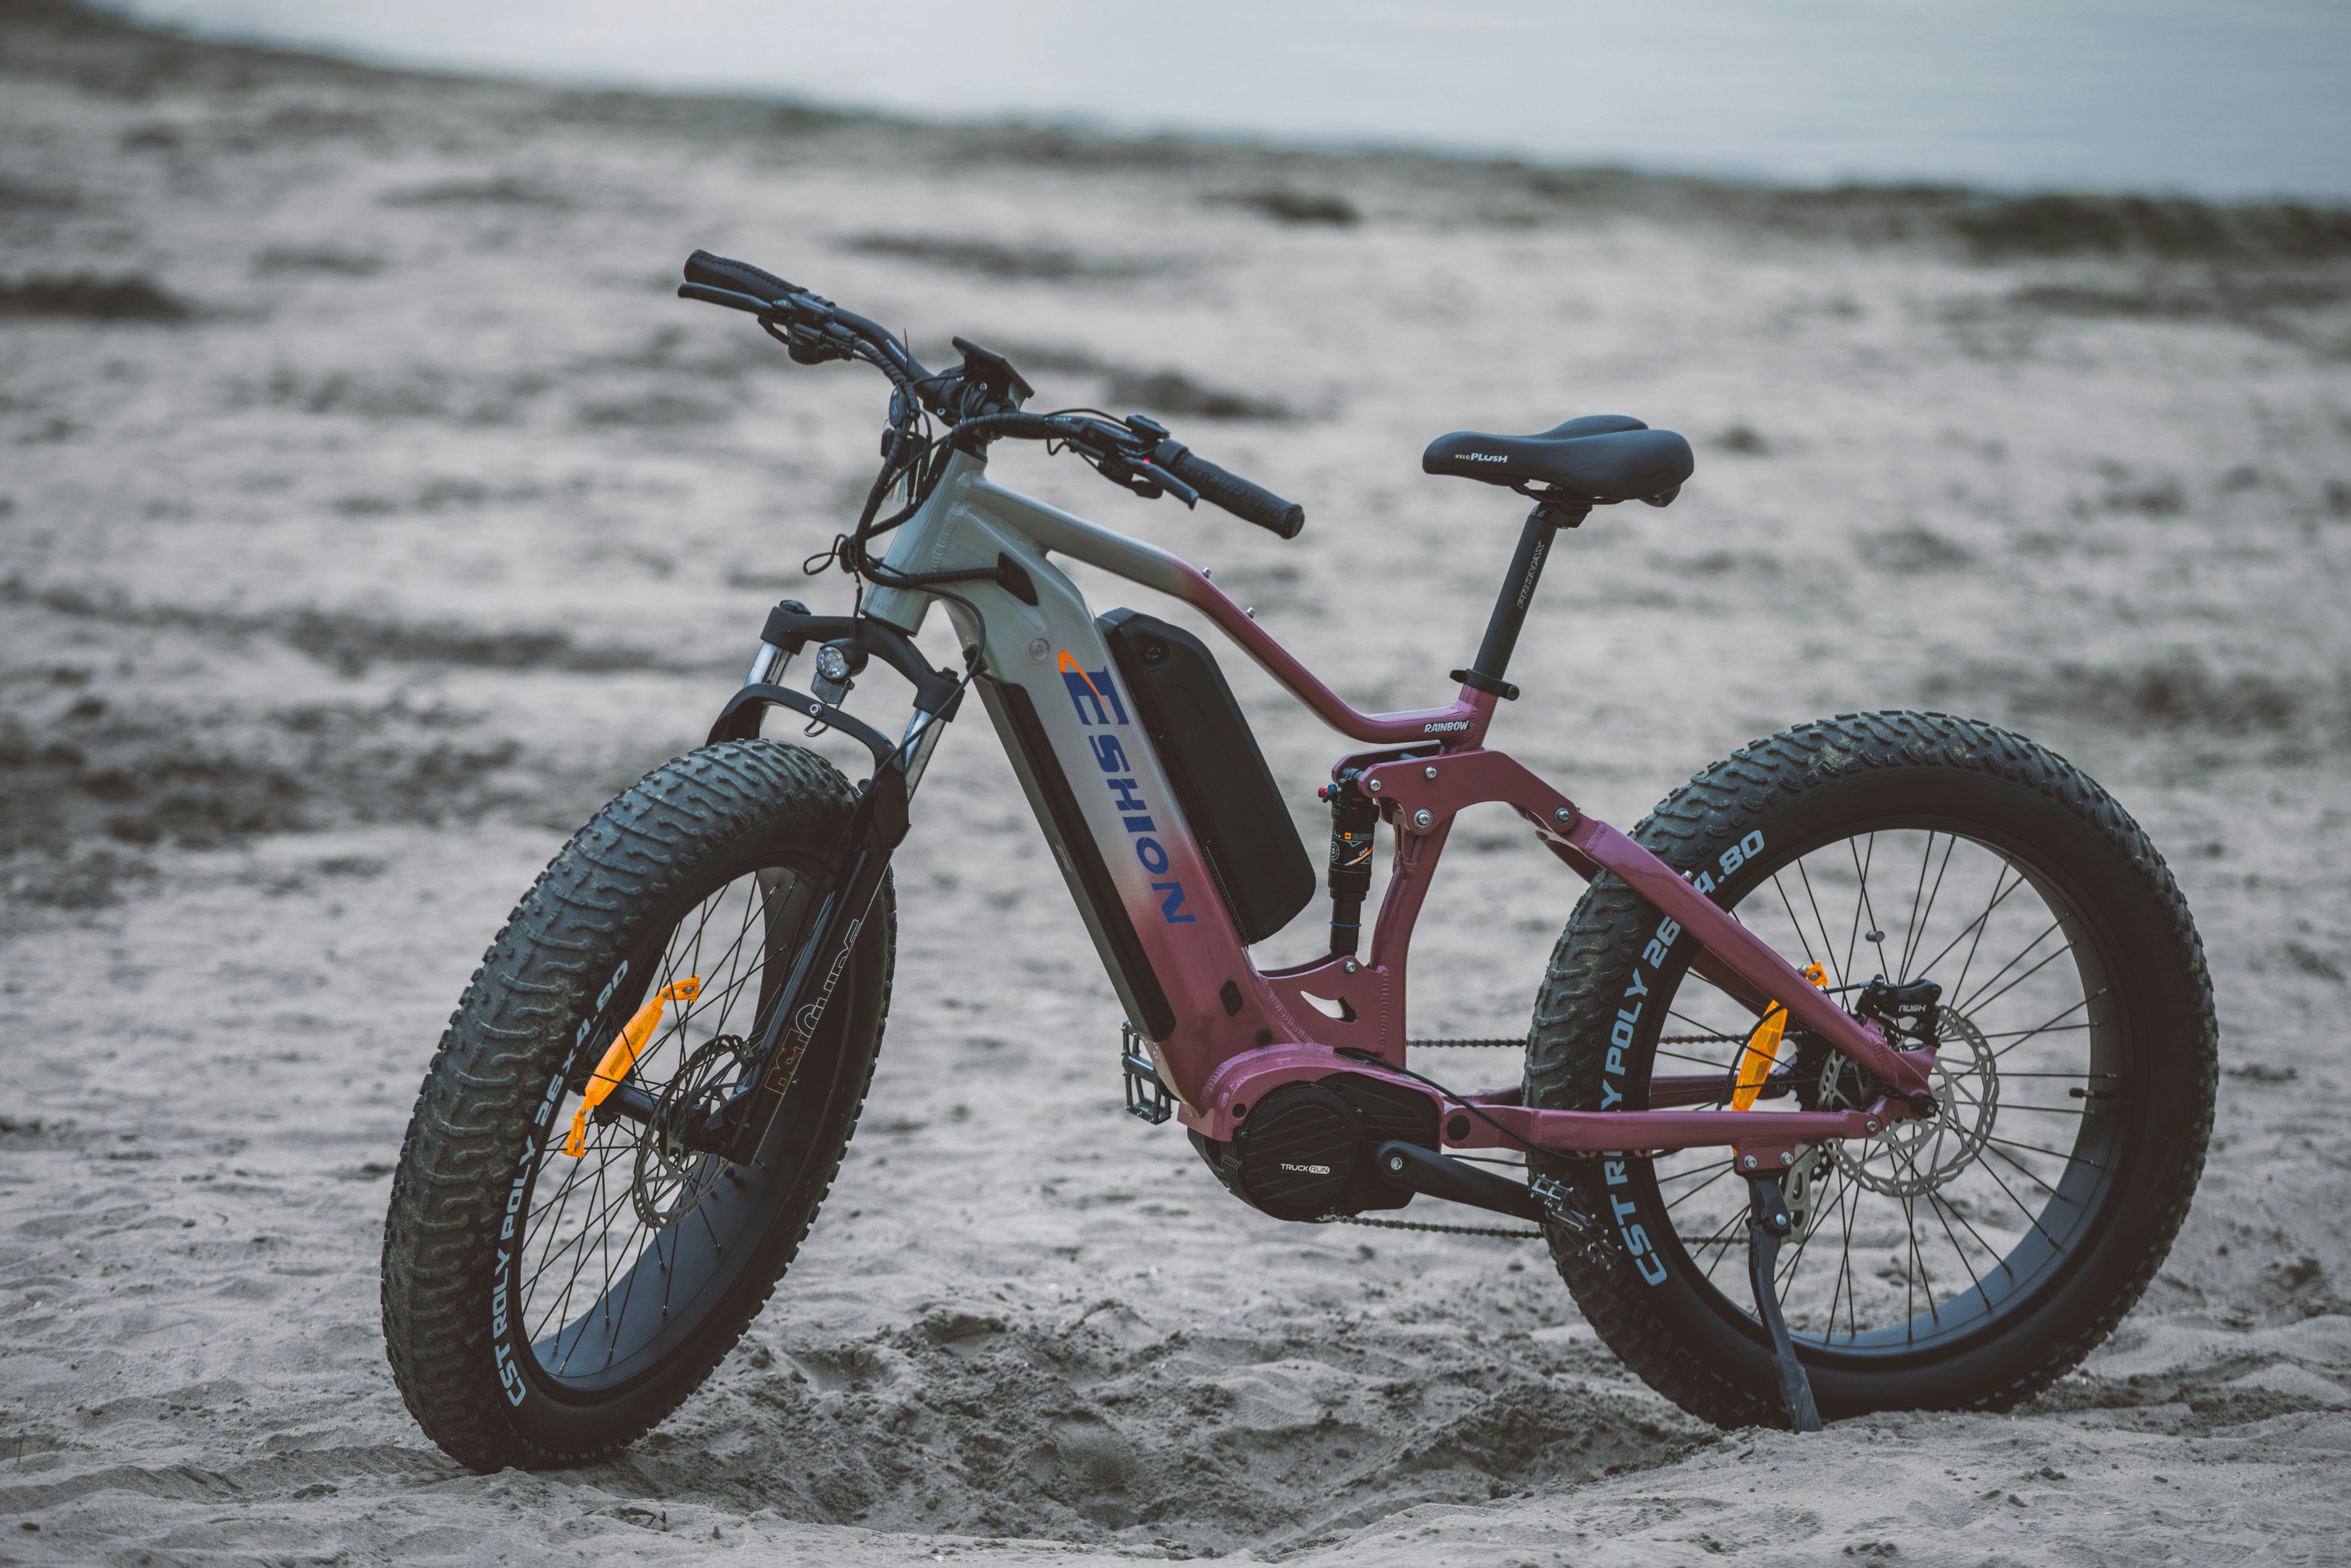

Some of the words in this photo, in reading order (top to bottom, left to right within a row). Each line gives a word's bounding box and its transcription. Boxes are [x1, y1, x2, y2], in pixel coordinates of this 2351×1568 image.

[1470, 452, 1508, 463] PLUSH
[1517, 540, 1545, 609] PROMAX
[1424, 720, 1470, 733] RAINBOW
[1693, 830, 1764, 895] 4.80
[1642, 915, 1682, 969] 26
[1605, 968, 1648, 1076] POLY
[1899, 1004, 1926, 1013] RUSH
[534, 1073, 563, 1127] 26
[1601, 1079, 1628, 1185] RY
[500, 1135, 536, 1240] POLY
[1610, 1194, 1667, 1286] CST
[492, 1248, 510, 1339] ROLY
[494, 1342, 526, 1407] CST
